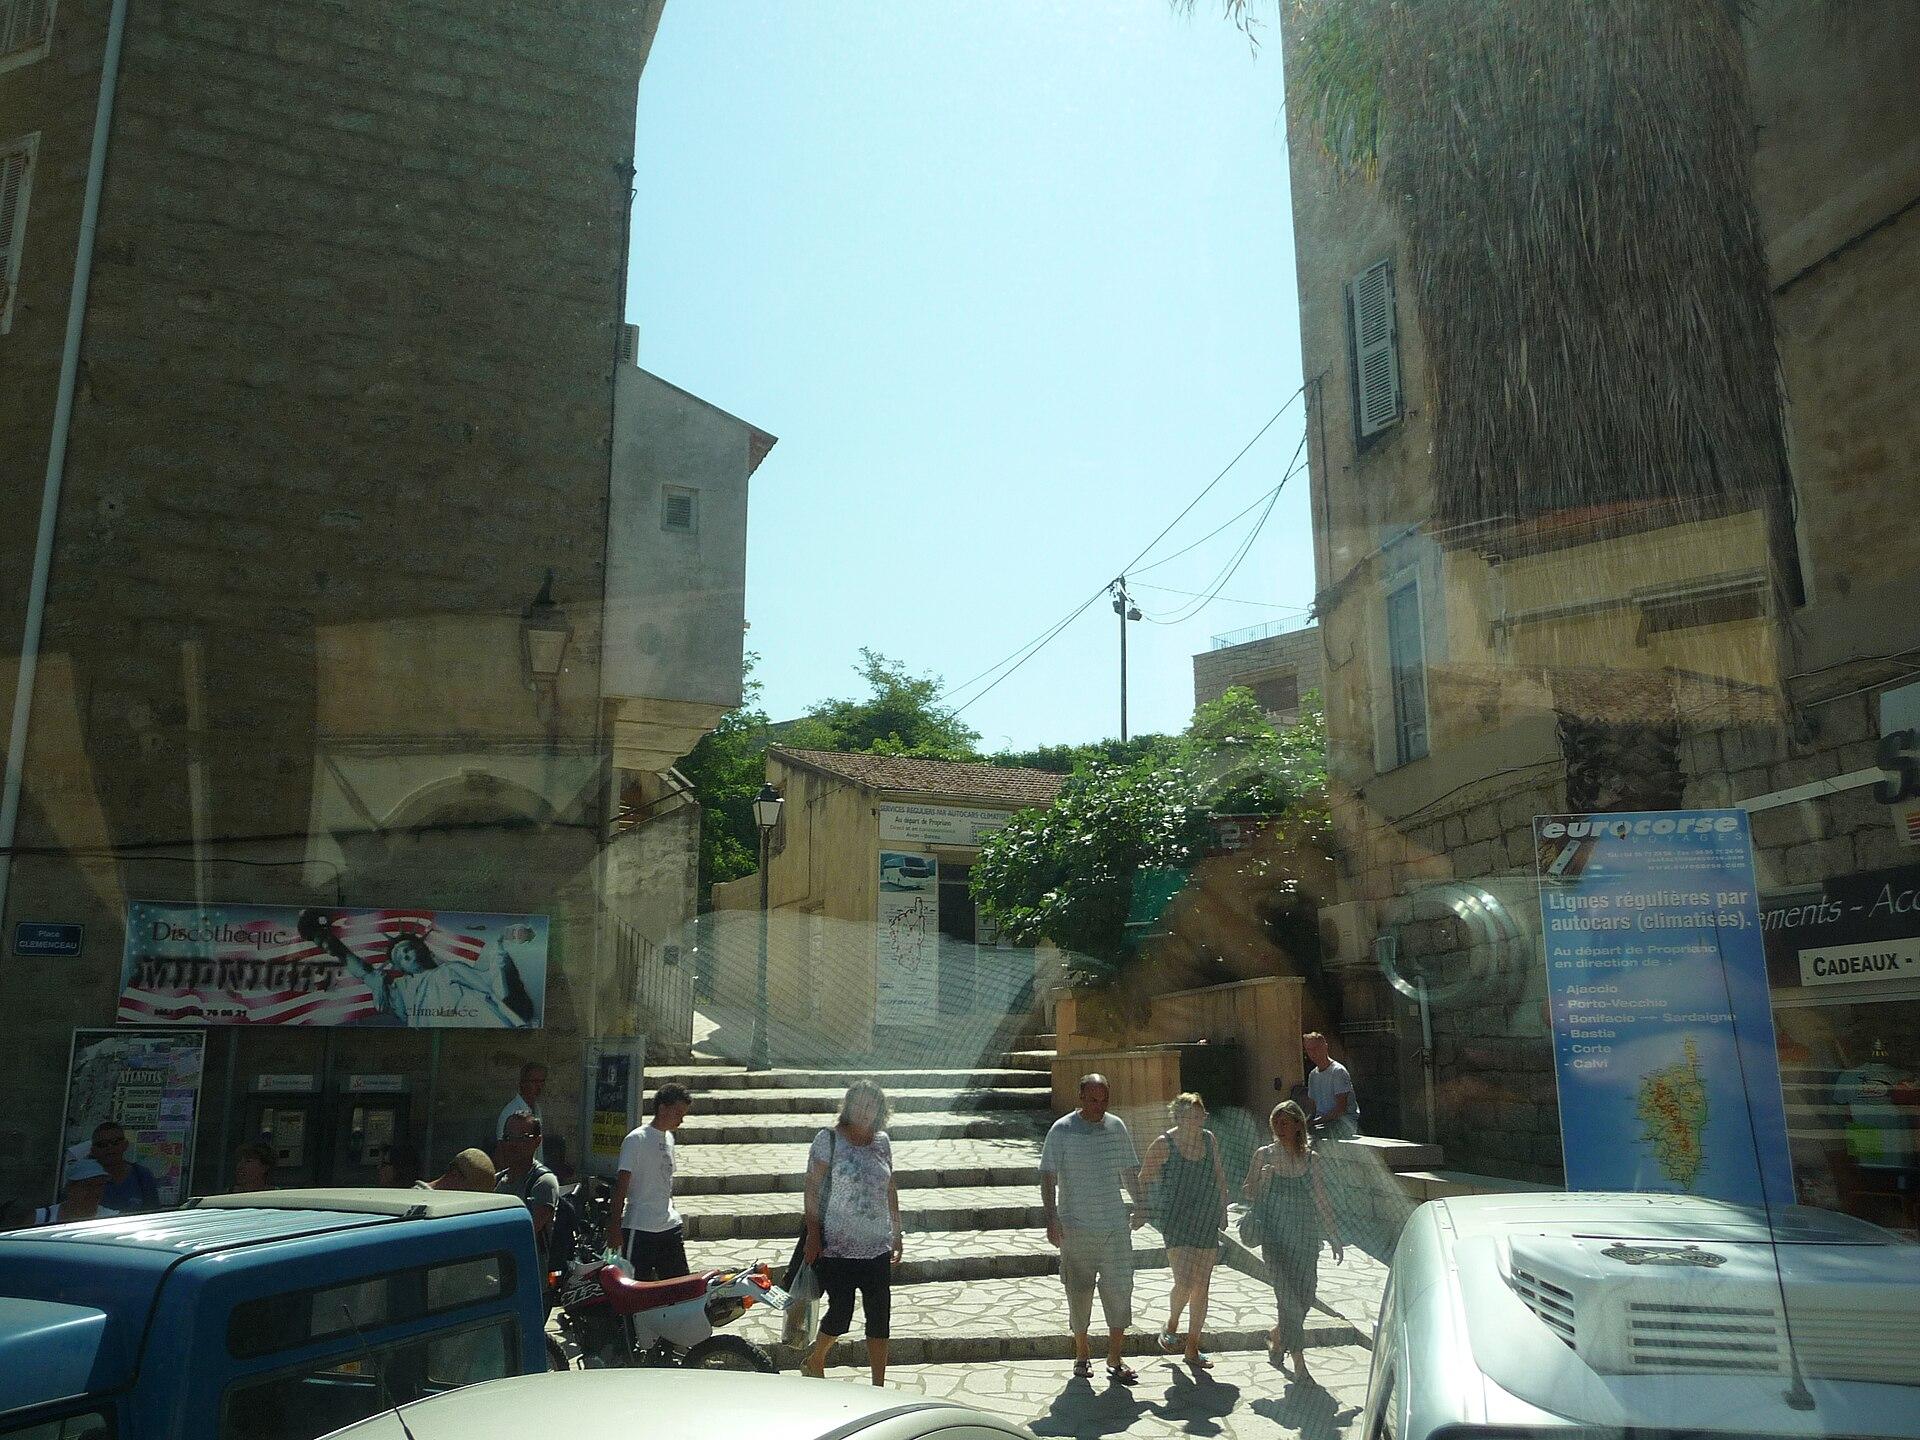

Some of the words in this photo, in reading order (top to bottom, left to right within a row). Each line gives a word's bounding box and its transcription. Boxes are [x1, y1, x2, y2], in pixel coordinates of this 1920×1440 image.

[879, 804, 905, 813] SERVICES
[947, 810, 979, 819] AUTOCARS
[895, 815, 903, 823] Au
[1543, 816, 1739, 839] eurocorse
[1632, 833, 1745, 844] VOYAGES
[1550, 893, 1609, 912] Lignes
[1616, 890, 1711, 911] régulières
[1717, 891, 1748, 909] par
[1551, 914, 1631, 932] autocars
[39, 930, 60, 938] Place
[151, 920, 288, 951] Discothèque
[19, 940, 77, 949] CLEMENCEAU
[1553, 946, 1572, 956] Au
[1575, 945, 1623, 958] départ
[1625, 945, 1645, 955] de
[1649, 944, 1718, 957] Propriano
[1554, 960, 1572, 969] en
[1576, 958, 1638, 969] direction
[1641, 957, 1660, 967] de
[1813, 952, 1899, 978] CADEAUX
[1566, 984, 1618, 995] Ajaccio
[1568, 999, 1668, 1009] Porto-Vecchio
[1569, 1013, 1636, 1024] Bonifacio
[1662, 1012, 1737, 1024] Sardaigne
[1570, 1028, 1616, 1039] Bastia
[1572, 1044, 1612, 1054] Corte
[1573, 1058, 1609, 1069] Calvi
